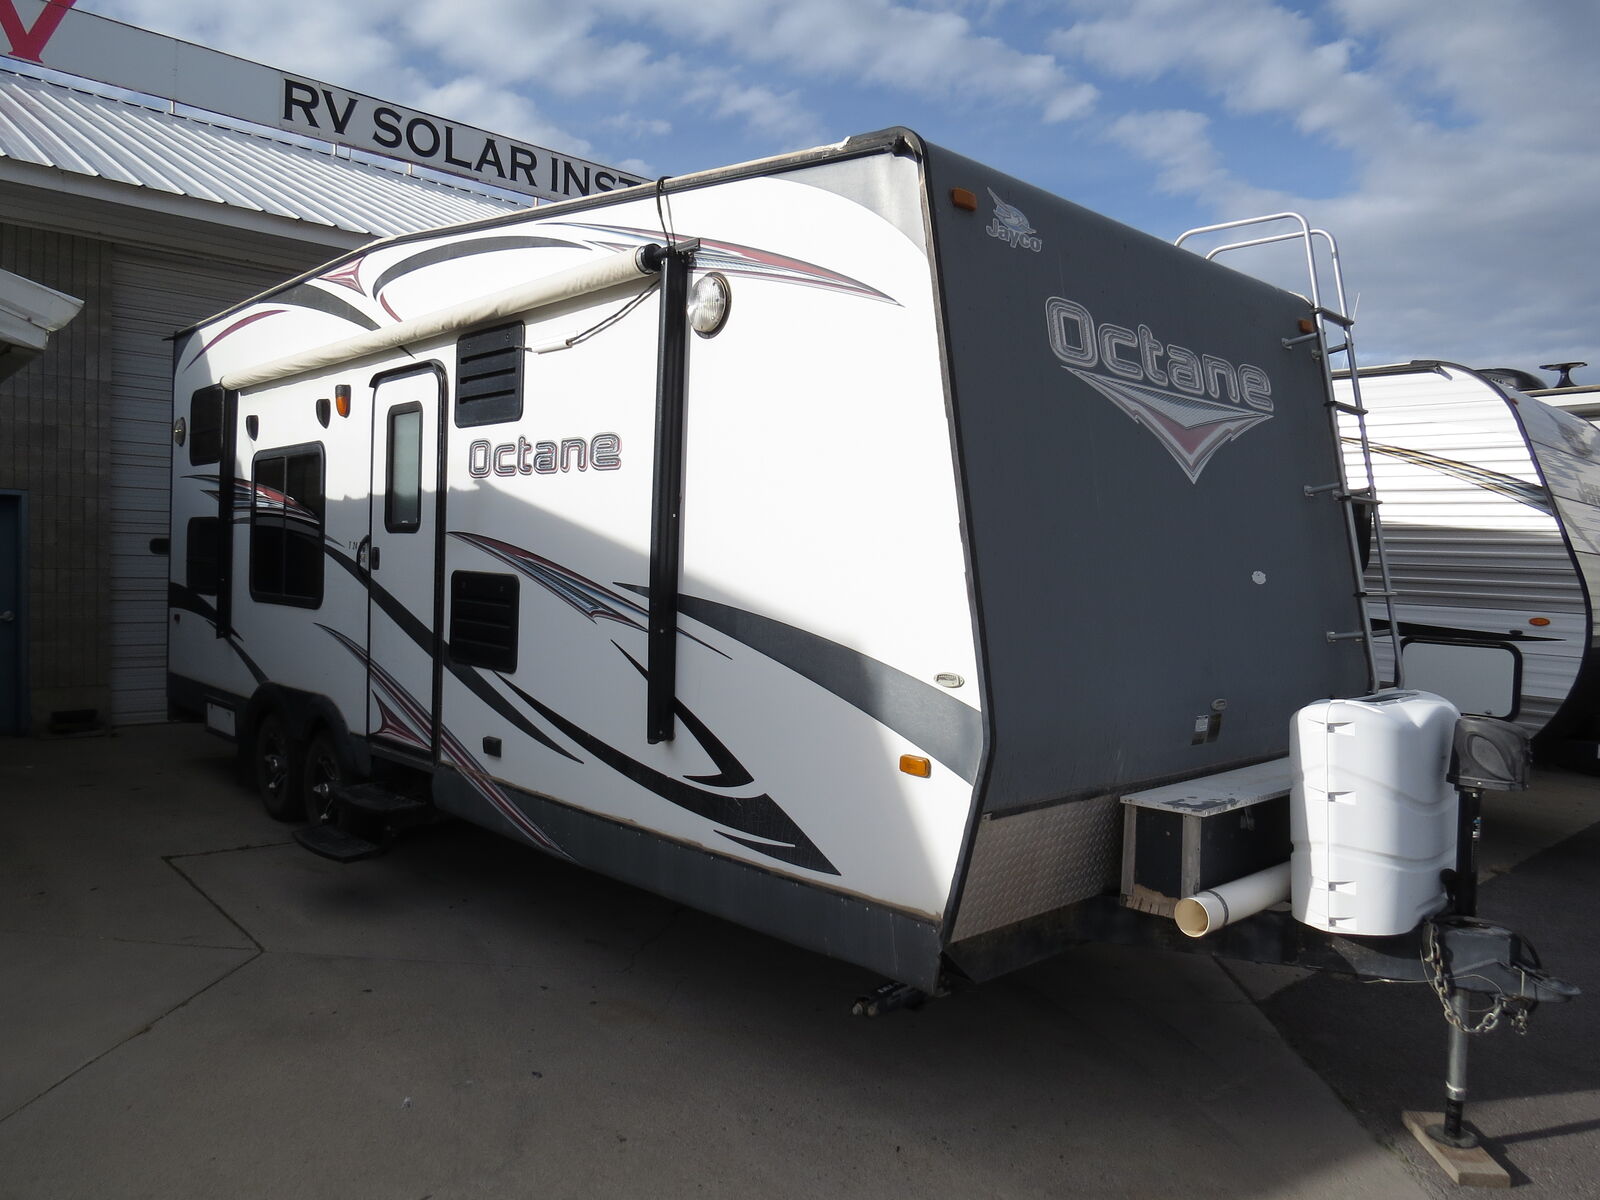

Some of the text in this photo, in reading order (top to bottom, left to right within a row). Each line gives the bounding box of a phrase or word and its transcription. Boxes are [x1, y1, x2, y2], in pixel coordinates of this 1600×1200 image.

[283, 78, 359, 135] RV
[372, 107, 538, 187] SOLAR
[986, 218, 1042, 252] Jayco
[1046, 296, 1274, 412] Octane
[469, 432, 623, 479] Octane
